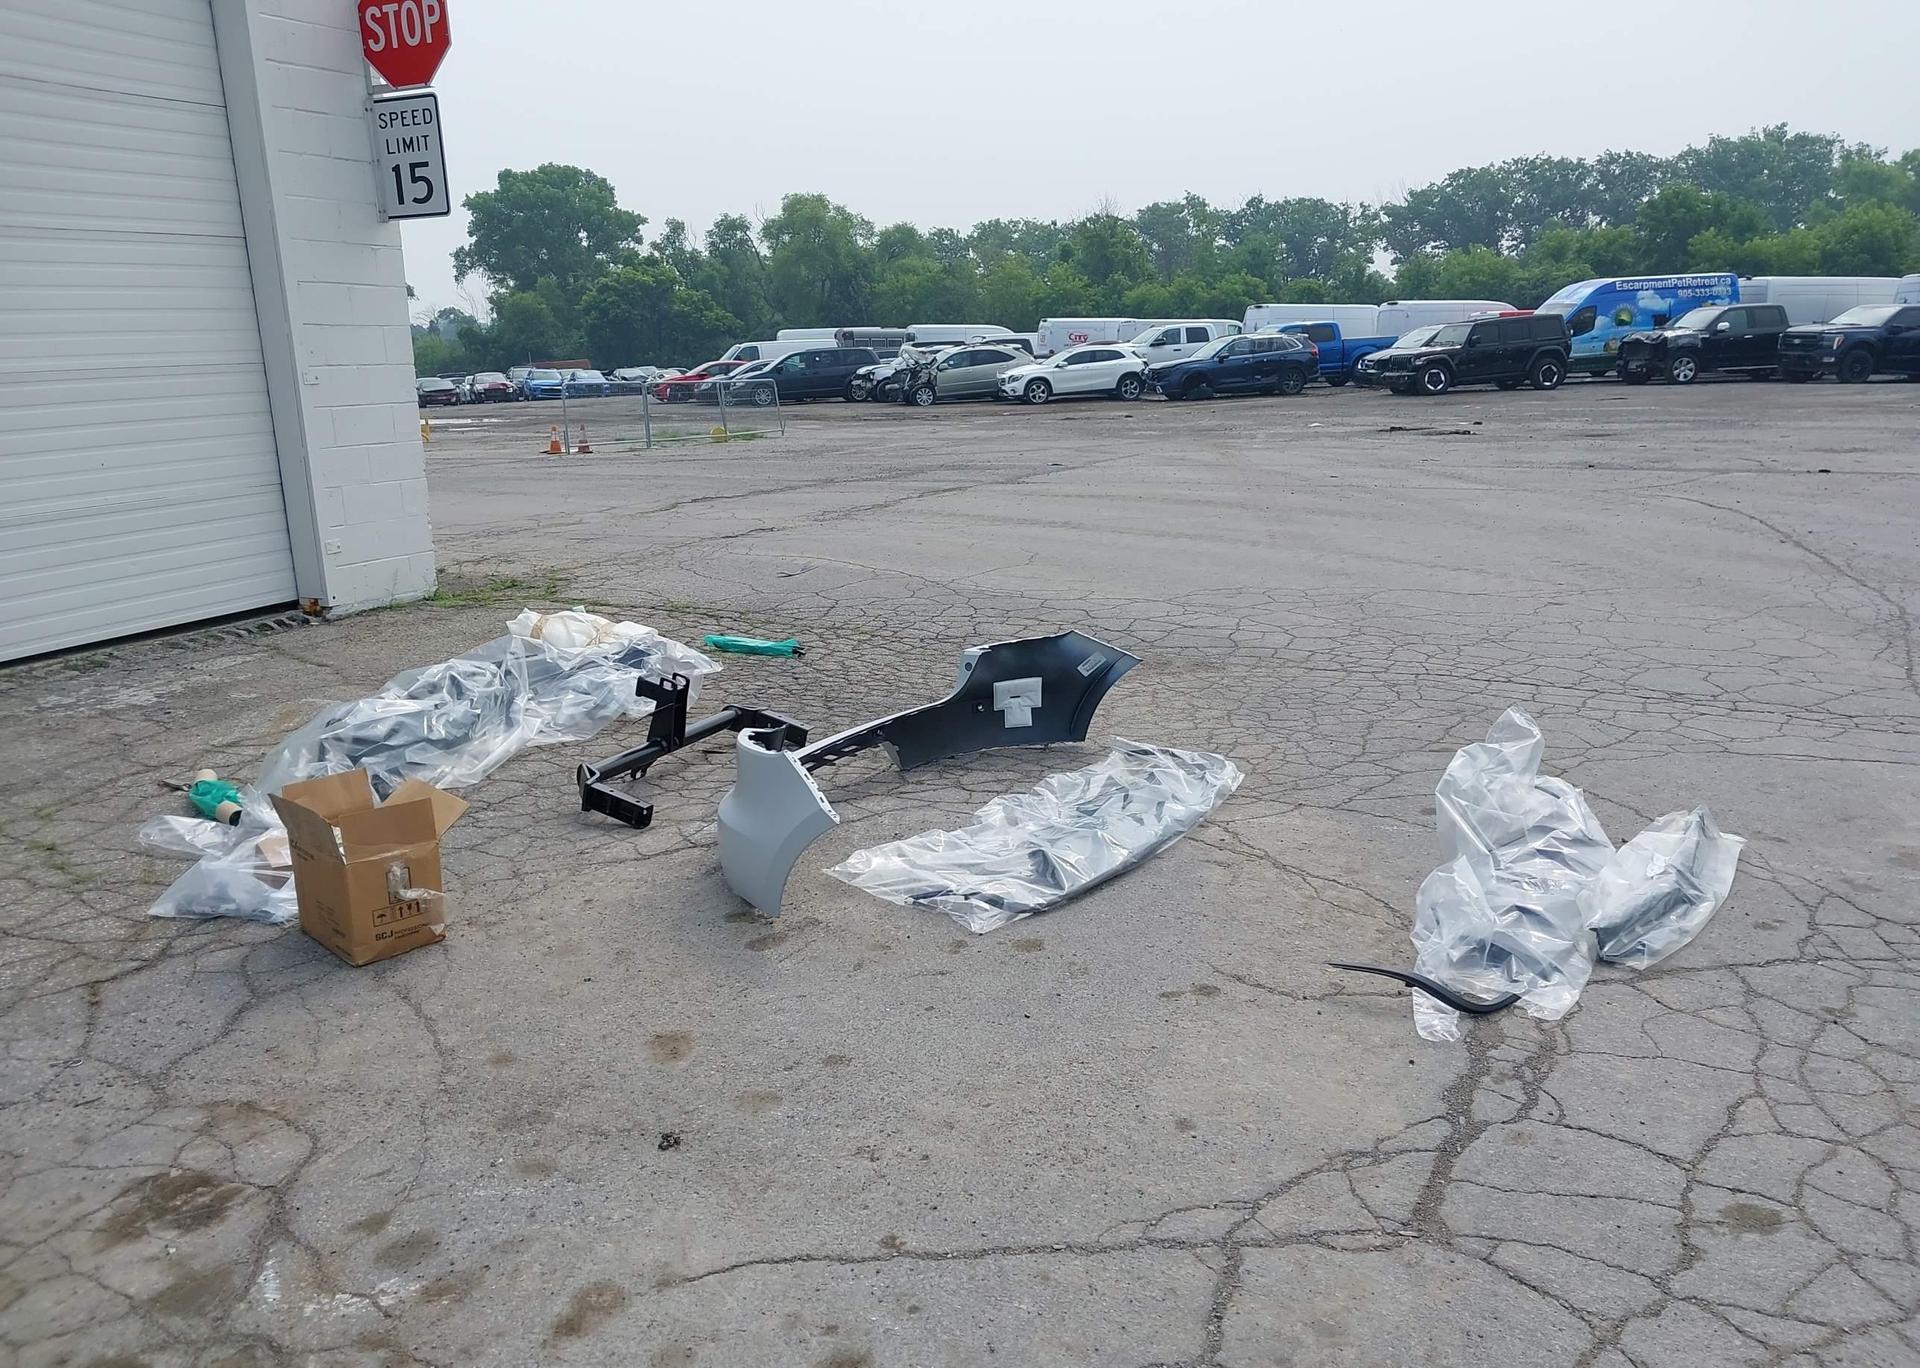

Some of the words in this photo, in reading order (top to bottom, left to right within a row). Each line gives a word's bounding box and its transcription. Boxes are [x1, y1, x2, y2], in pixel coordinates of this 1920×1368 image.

[365, 0, 441, 52] STOP
[378, 108, 433, 130] SPEED
[386, 135, 430, 155] LIMIT
[391, 161, 434, 206] 15
[1615, 276, 1731, 291] EscarpmentPetRetreat.ca
